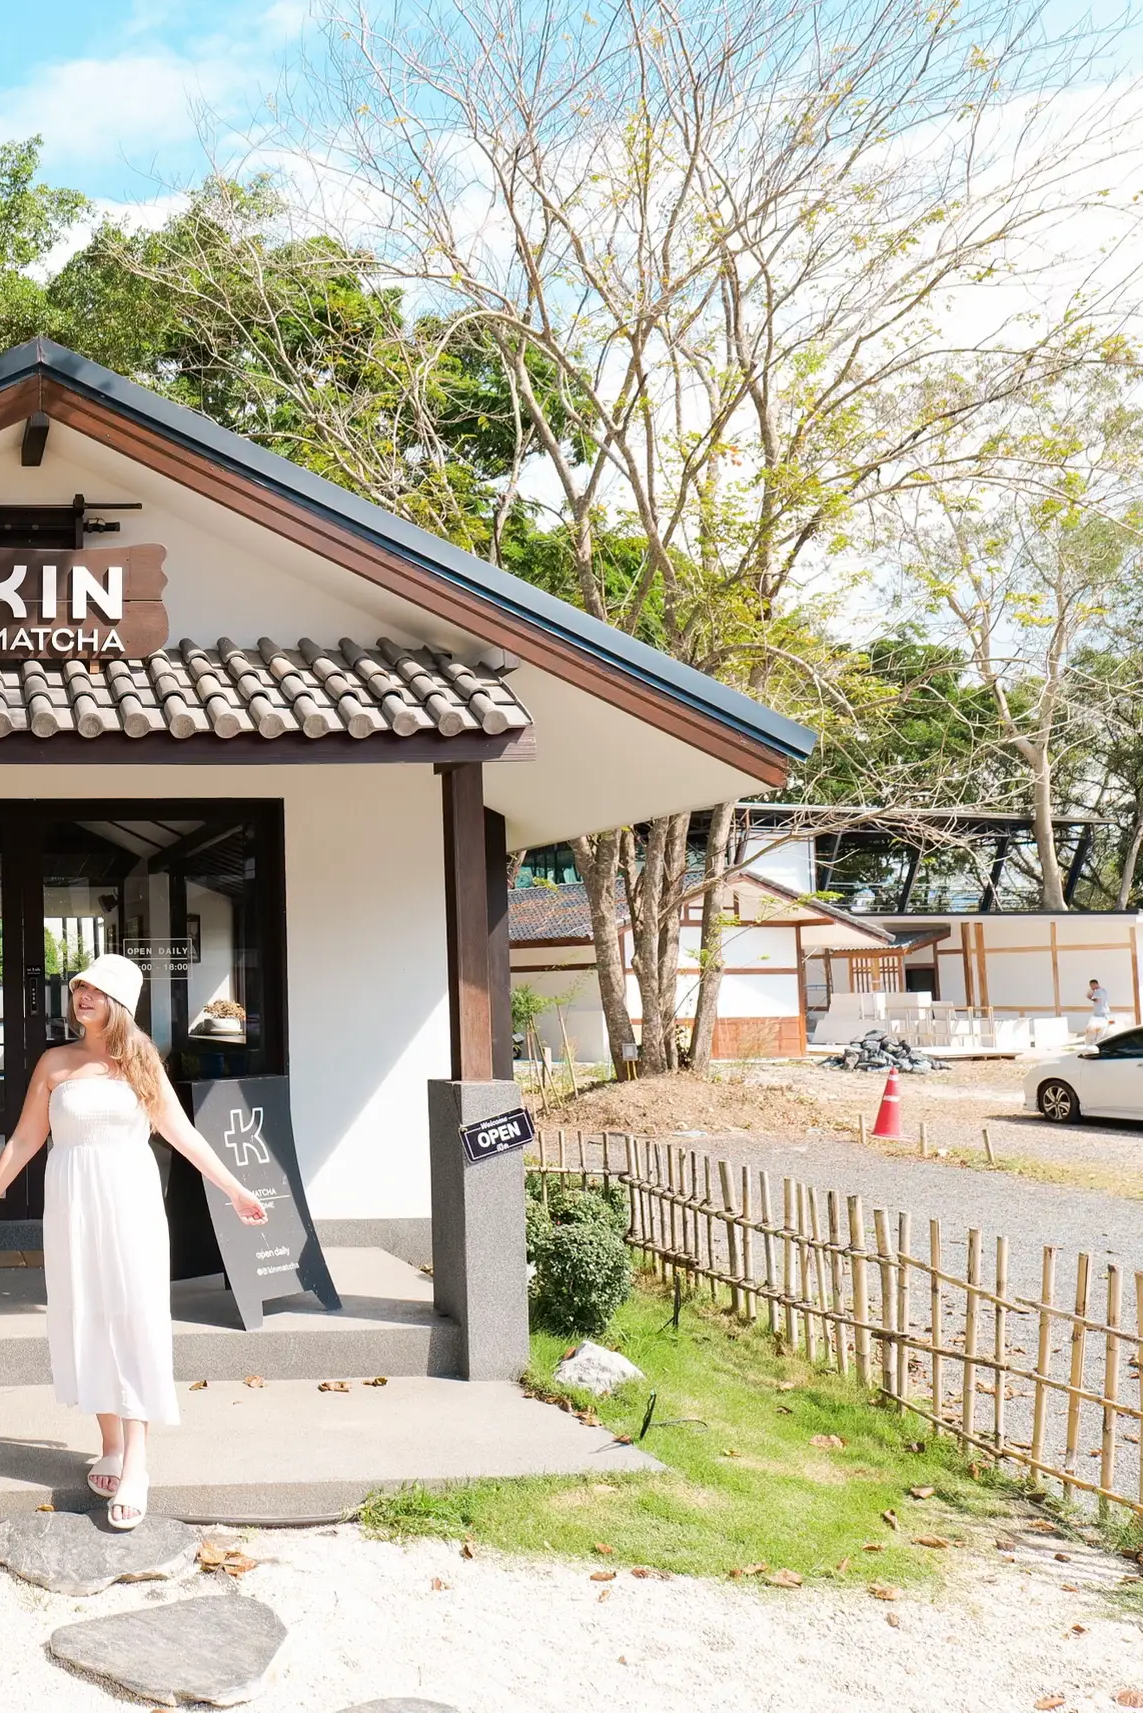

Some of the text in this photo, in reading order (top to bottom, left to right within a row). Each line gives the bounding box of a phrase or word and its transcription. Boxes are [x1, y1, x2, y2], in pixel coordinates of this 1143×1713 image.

[127, 947, 188, 955] OPEN DAILY
[163, 963, 188, 971] 18:00
[480, 1117, 508, 1129] Welcome
[477, 1121, 521, 1147] OPEN
[255, 1245, 290, 1260] open daily
